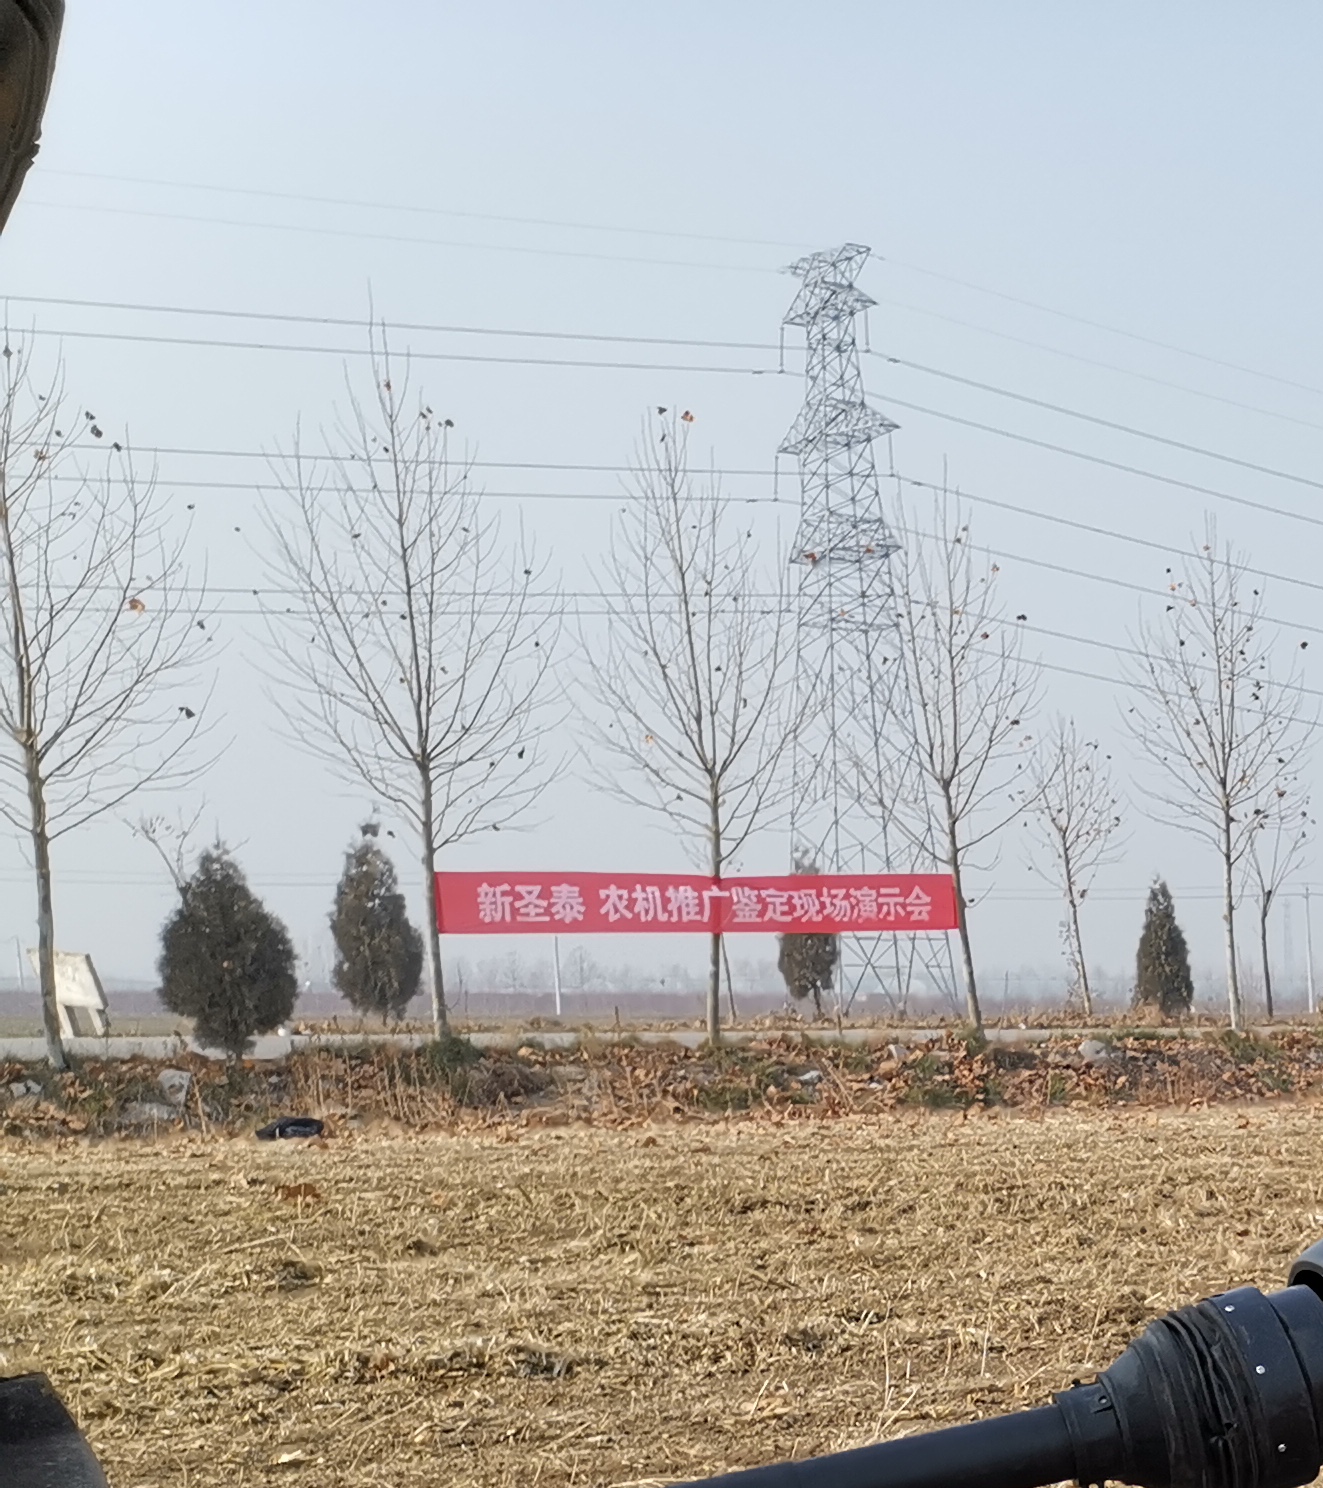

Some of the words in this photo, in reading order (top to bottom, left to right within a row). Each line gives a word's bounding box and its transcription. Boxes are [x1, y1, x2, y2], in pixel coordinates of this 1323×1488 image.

[476, 882, 586, 923] 新圣泰
[599, 884, 932, 923] 农机推广鉴定现场演示会
